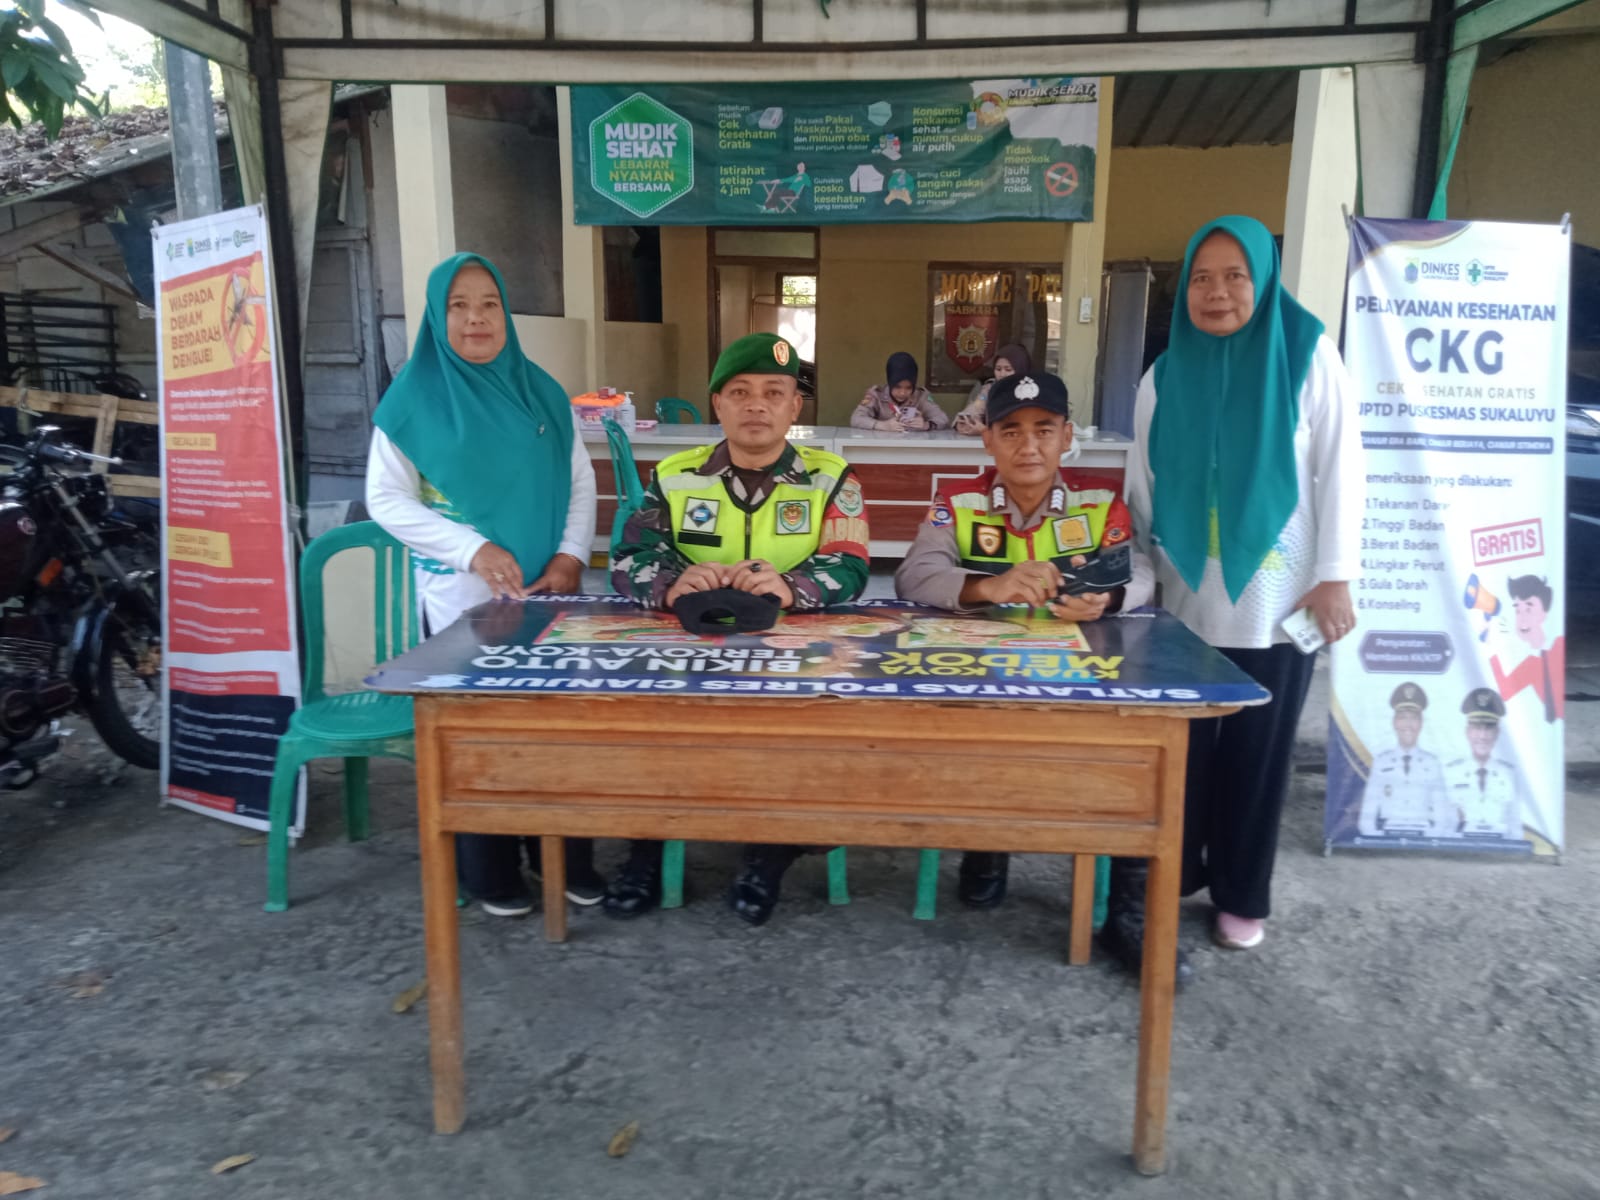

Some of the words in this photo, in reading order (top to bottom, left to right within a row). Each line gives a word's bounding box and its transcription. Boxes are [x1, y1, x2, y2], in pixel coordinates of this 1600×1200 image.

[912, 106, 964, 116] Konsumsi
[719, 119, 740, 129] Cek
[825, 114, 854, 124] Pakai
[912, 116, 961, 125] makanan
[604, 122, 679, 141] MUDIK
[719, 129, 777, 139] Kesehatan
[794, 124, 833, 134] Masker,
[835, 124, 863, 134] bawa
[912, 125, 941, 134] sehat
[719, 139, 752, 149] Gratis
[809, 134, 845, 142] minum
[847, 134, 870, 142] obat
[912, 135, 950, 143] minum
[951, 134, 984, 144] cukup
[606, 141, 677, 159] SEHAT
[912, 143, 926, 152] air
[928, 142, 955, 154] putih
[613, 159, 670, 170] LEBARAN
[1004, 154, 1050, 164] merokok
[609, 170, 675, 182] NYAMAN
[720, 165, 766, 175] Istirahat
[940, 168, 961, 177] cuci
[720, 175, 753, 186] setiap
[917, 179, 953, 189] tangan
[1003, 176, 1028, 186] asap
[613, 182, 673, 193] BERSAMA
[720, 186, 727, 195] 4
[729, 185, 751, 197] jam
[814, 184, 844, 195] posko
[917, 189, 948, 198] sabun
[1003, 184, 1032, 193] rokok
[814, 193, 866, 203] kesehatan
[1421, 261, 1460, 276] DINKES
[169, 287, 214, 312] WASPADA
[1355, 295, 1453, 318] PELAYANAN
[1457, 301, 1556, 322] KESEHATAN
[171, 326, 222, 350] BERDARAH
[1404, 327, 1504, 376] CKG
[1376, 381, 1405, 395] CEK
[1487, 387, 1536, 400] GRATIS
[1398, 403, 1476, 421] PUSKESMAS
[1479, 407, 1556, 423] SUKALUYU
[1366, 472, 1431, 484] emeriksaan
[1408, 519, 1445, 532] Badan
[1402, 539, 1440, 551] Badan
[1477, 528, 1538, 557] GRATIS
[1413, 559, 1446, 572] Perut
[1396, 579, 1429, 591] Darah
[479, 645, 803, 660] TERKOYA-KOYA
[471, 655, 634, 671] AUTO
[646, 658, 802, 673] BIKIN
[880, 651, 1125, 670] MEDOK
[879, 665, 988, 676] KOYA
[1003, 667, 1120, 680] KUAH
[473, 677, 688, 690] CIANJUR
[701, 680, 899, 693] POLRES
[912, 682, 1201, 700] SATLANTAS
